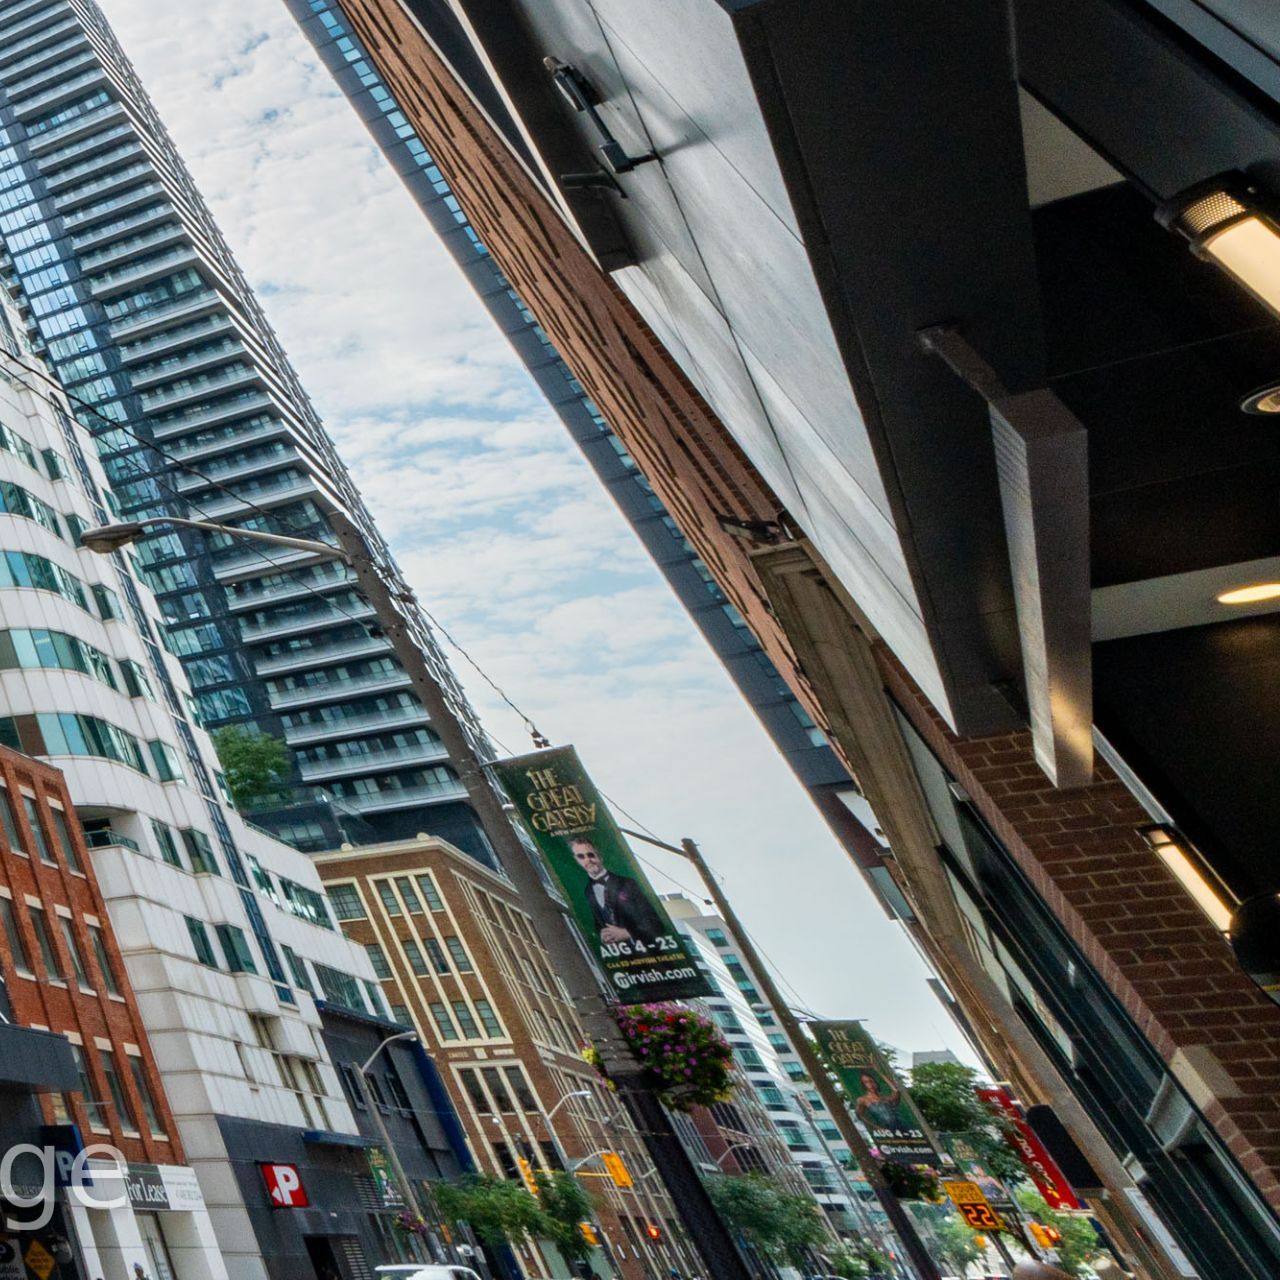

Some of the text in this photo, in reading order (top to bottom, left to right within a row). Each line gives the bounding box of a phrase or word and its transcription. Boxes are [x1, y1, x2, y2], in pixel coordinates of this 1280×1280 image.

[526, 768, 559, 791] THE
[527, 785, 584, 811] GREAT
[531, 803, 596, 832] GATSBY
[600, 942, 632, 959] AUG
[56, 1150, 76, 1181] P
[139, 1177, 168, 1202] Lease
[274, 1165, 300, 1205] P
[963, 1205, 995, 1226] 22
